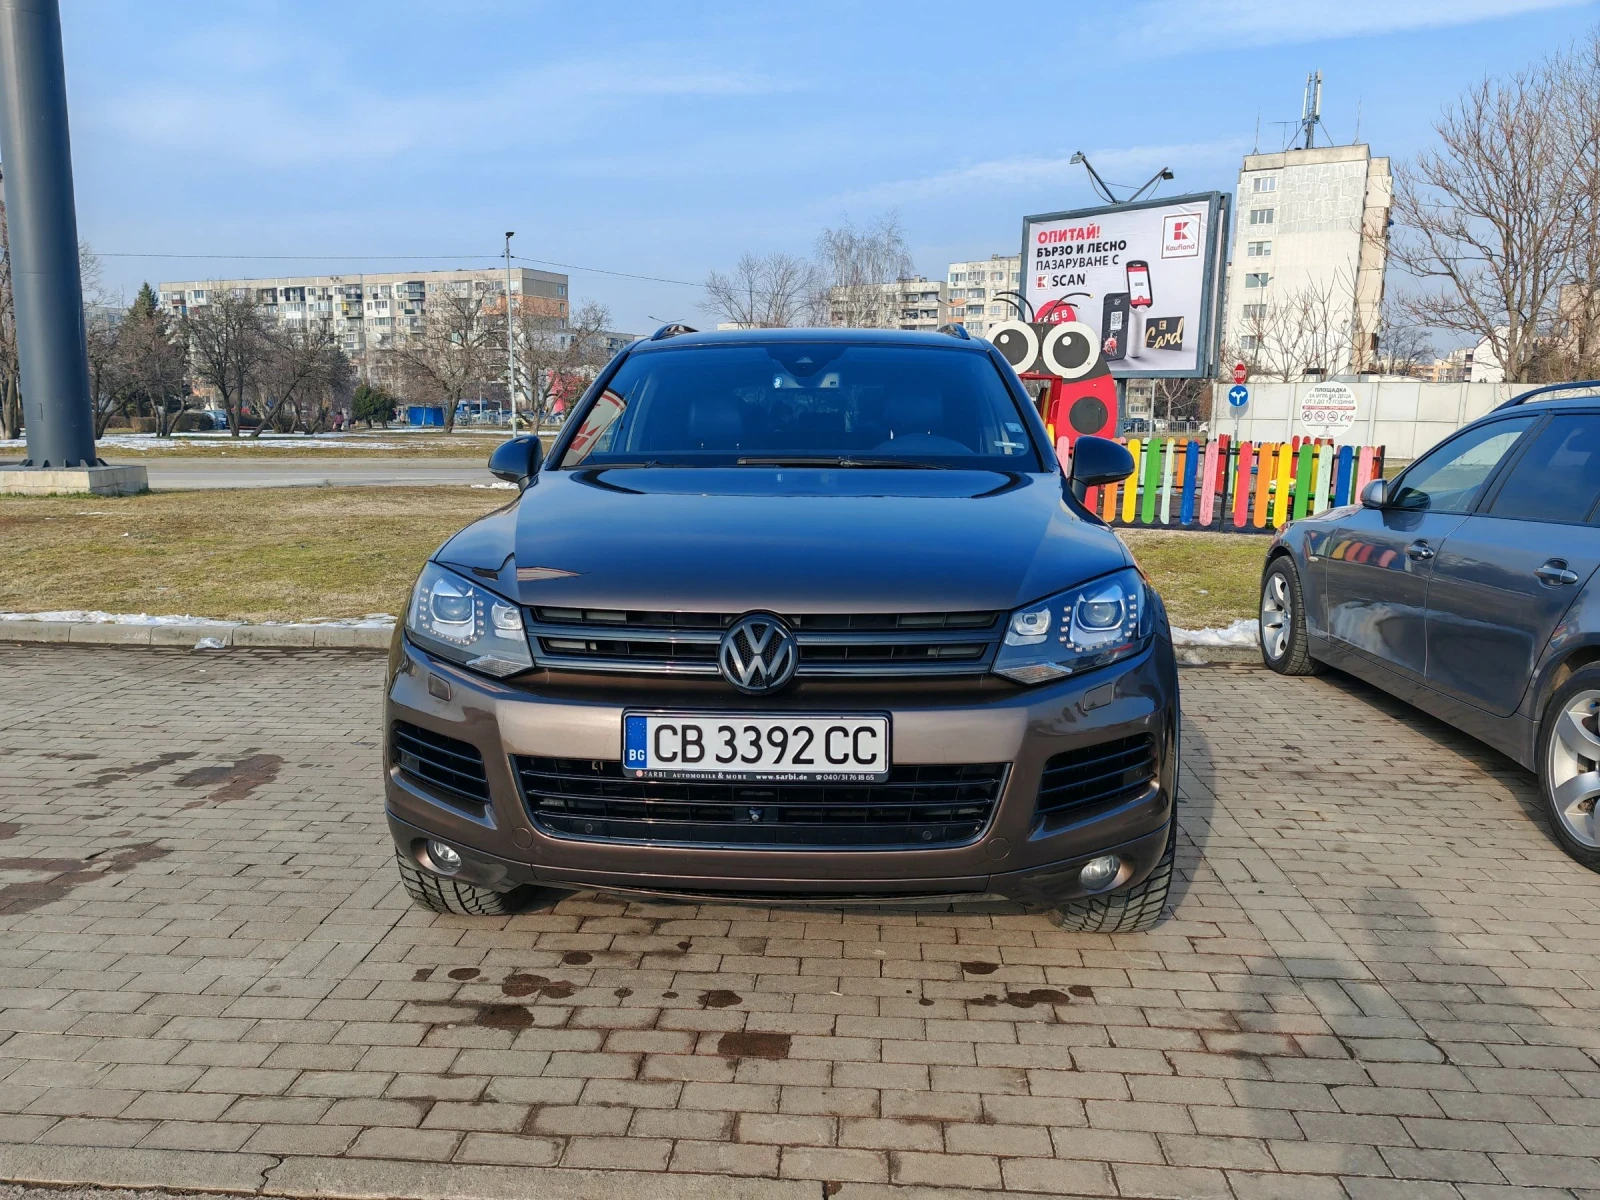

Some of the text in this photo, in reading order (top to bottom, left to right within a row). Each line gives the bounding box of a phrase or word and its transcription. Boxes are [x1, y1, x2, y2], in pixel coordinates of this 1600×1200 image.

[1037, 223, 1100, 244] ОПИТАЙ!
[1037, 240, 1127, 258] БЪРЗО И ЛЕСНО
[1165, 242, 1195, 251] Kaufland
[1036, 254, 1119, 271] ПАЗАРУВАНЕ С
[1052, 273, 1086, 287] SCAN
[1234, 370, 1246, 378] STOP
[654, 724, 877, 765] CB 3392 CC
[629, 749, 645, 761] BG
[717, 771, 724, 779] &
